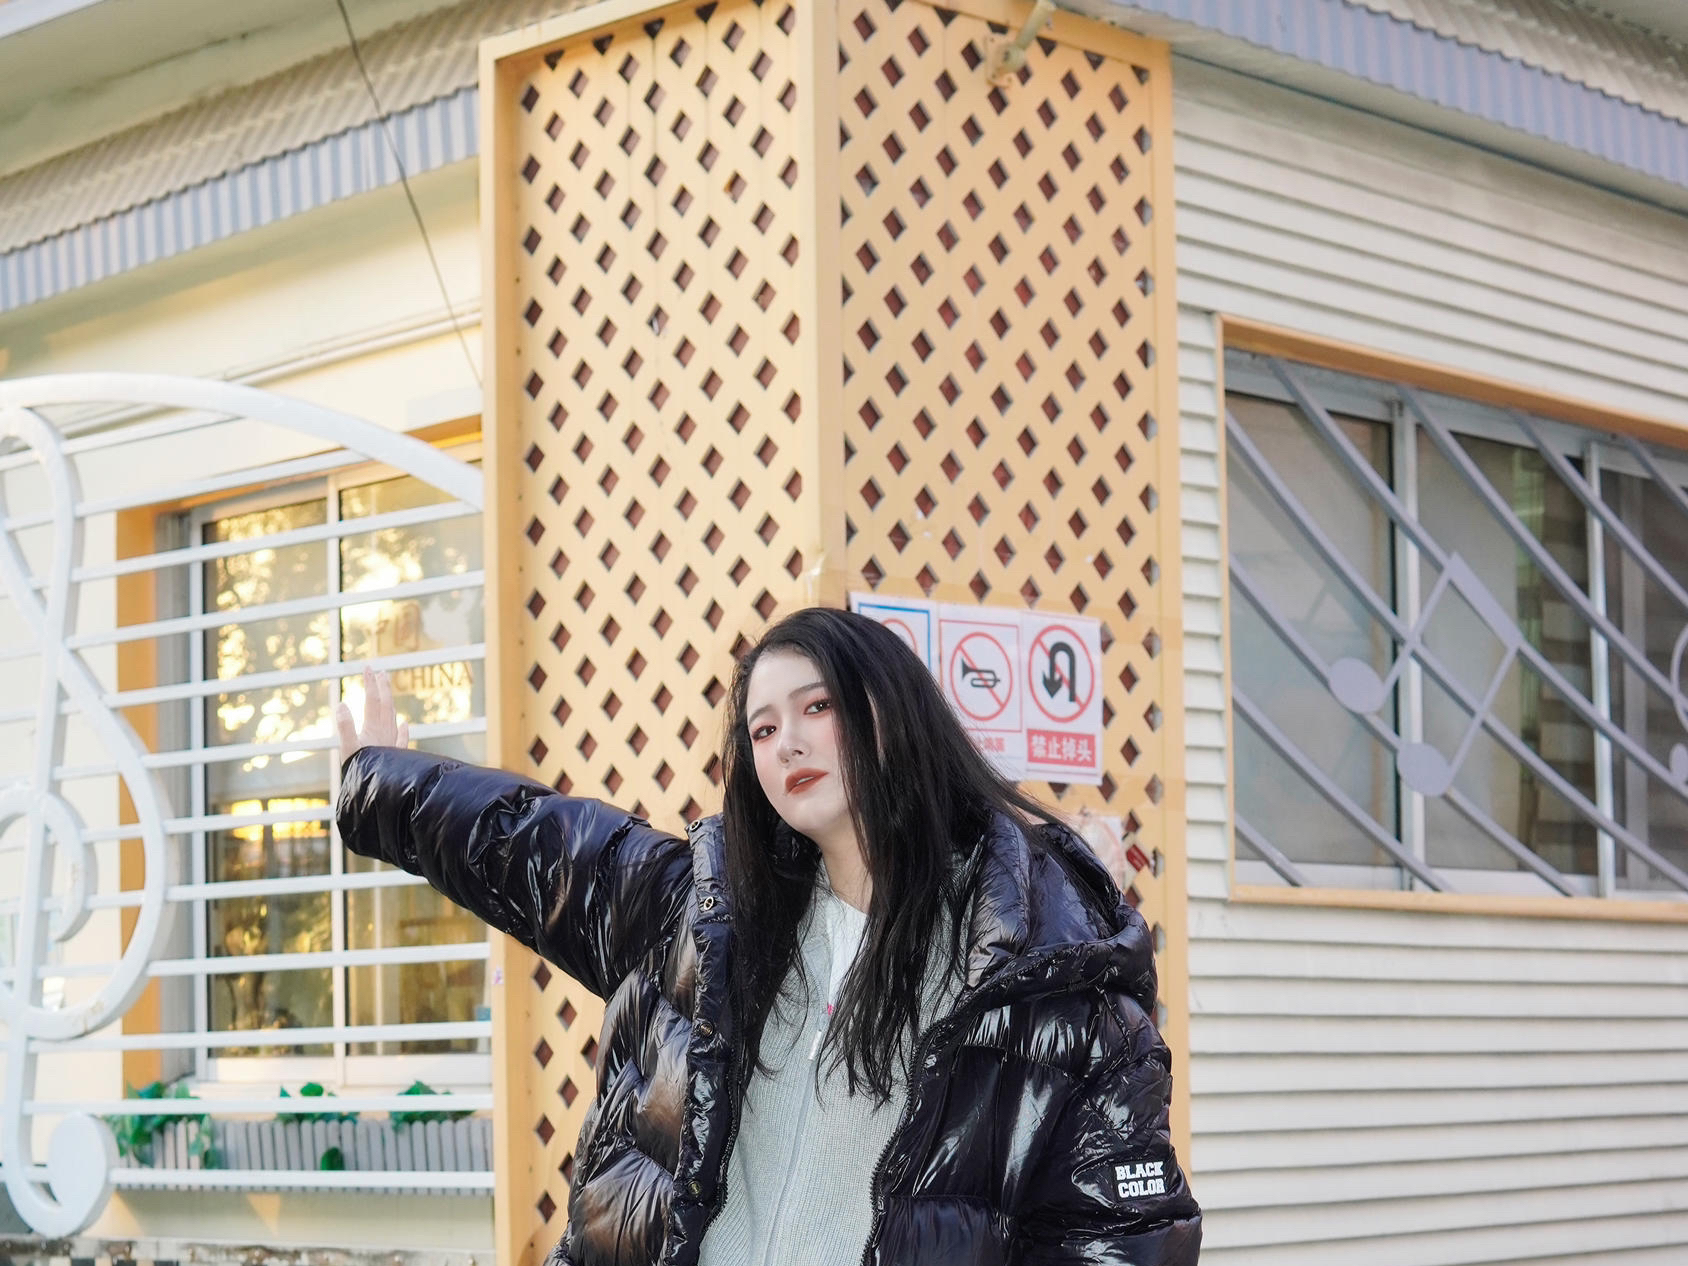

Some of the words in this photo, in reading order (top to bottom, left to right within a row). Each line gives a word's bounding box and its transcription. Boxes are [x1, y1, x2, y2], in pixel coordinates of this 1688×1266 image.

[391, 660, 474, 692] CHINA
[1031, 734, 1092, 762] 禁止掉头
[1115, 1161, 1164, 1181] BLACK
[1118, 1178, 1166, 1199] COLOR
